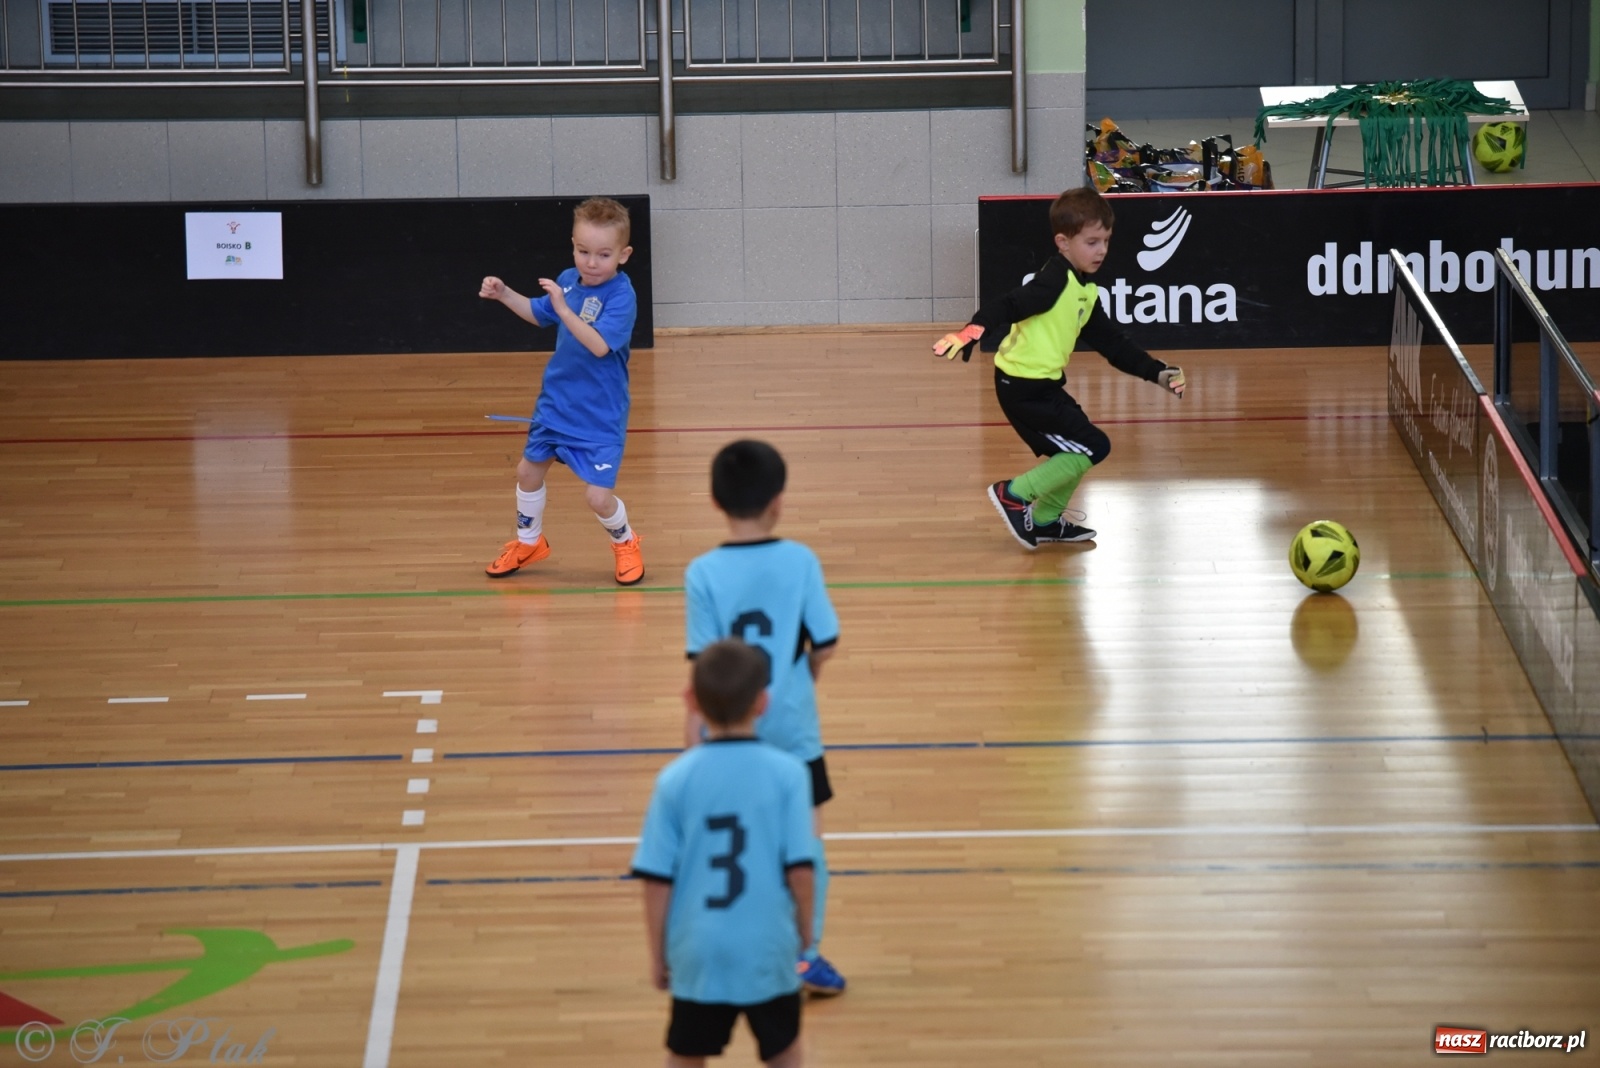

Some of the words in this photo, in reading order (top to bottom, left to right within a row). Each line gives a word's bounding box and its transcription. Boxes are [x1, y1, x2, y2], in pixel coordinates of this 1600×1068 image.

[245, 242, 251, 250] B
[1389, 282, 1424, 416] AMK
[705, 813, 748, 911] 3
